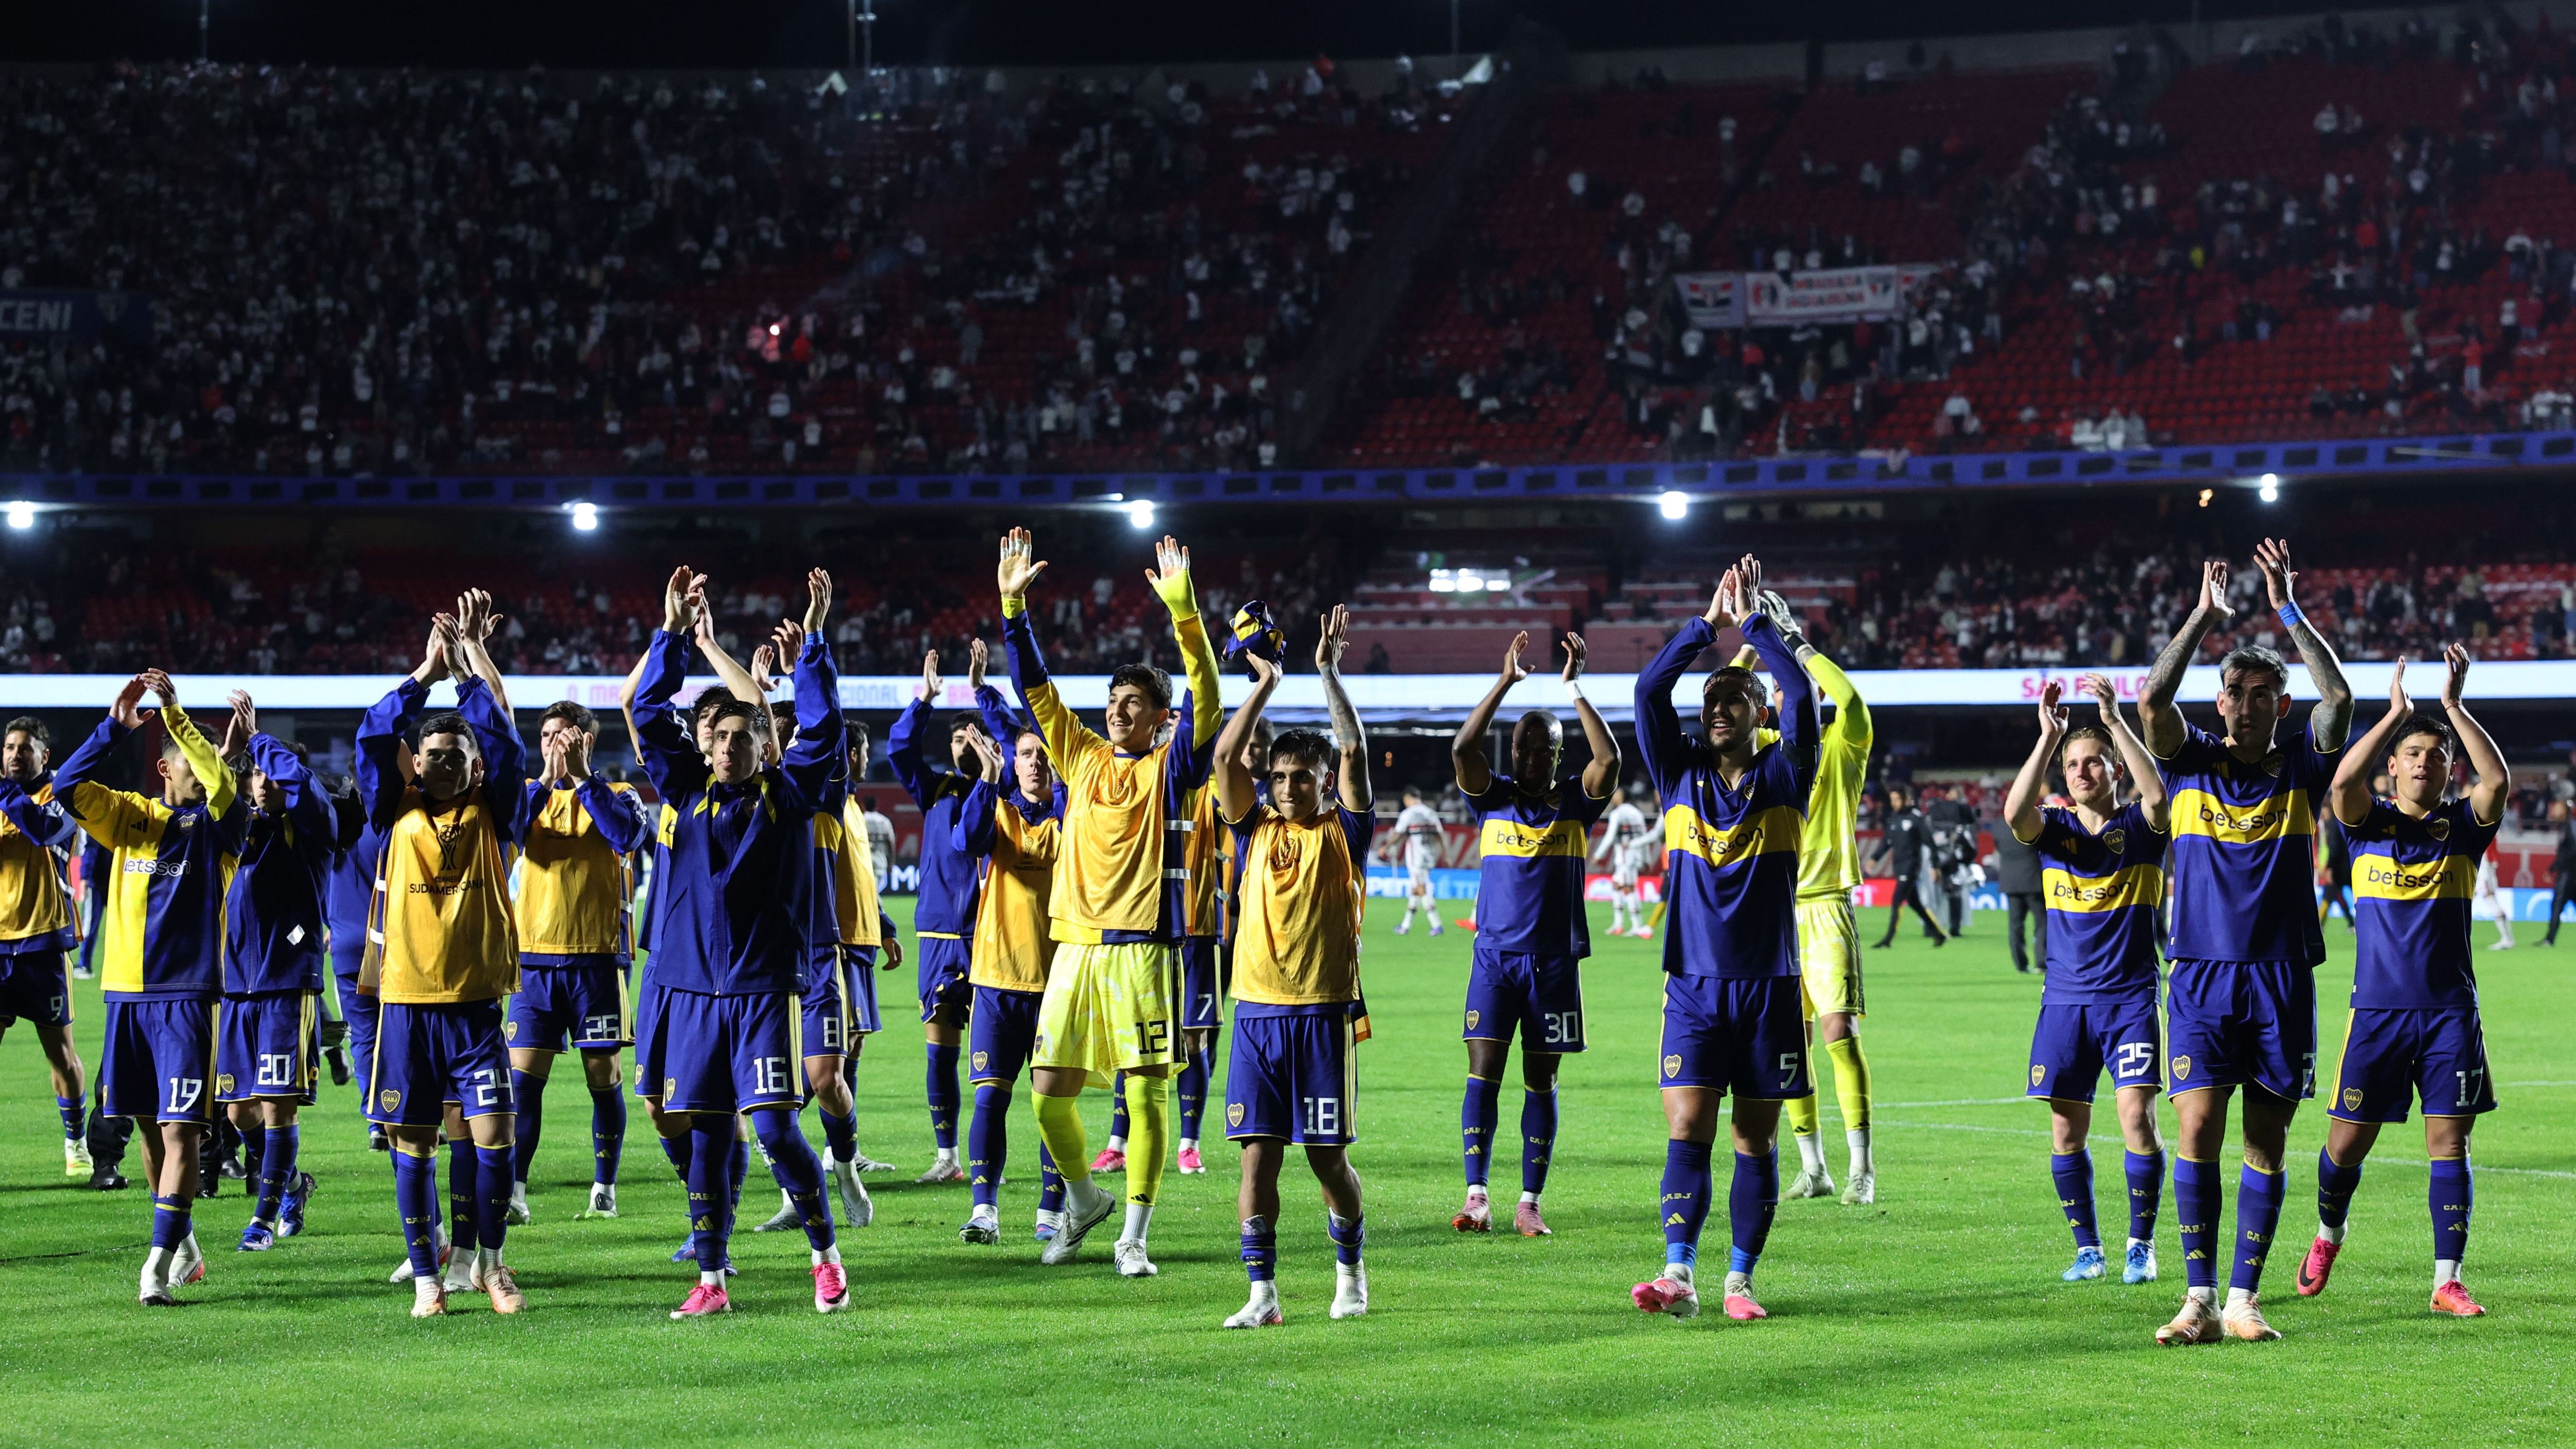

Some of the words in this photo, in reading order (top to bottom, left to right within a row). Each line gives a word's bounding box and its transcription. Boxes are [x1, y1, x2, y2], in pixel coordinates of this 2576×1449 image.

[2199, 804, 2289, 831] betsson
[1497, 830, 1569, 847] betsson
[1688, 822, 1764, 854] betsson
[2053, 881, 2131, 901] betsson
[2368, 866, 2454, 888] betsson
[51, 995, 64, 1021] 9
[1197, 993, 1213, 1021] 7
[585, 1014, 621, 1040] 26
[824, 1017, 840, 1048] 8
[1136, 1020, 1168, 1055] 12
[1544, 1011, 1579, 1043] 30
[257, 1053, 290, 1086] 20
[754, 1057, 789, 1094] 16
[1779, 1052, 1799, 1090] 5
[2118, 1042, 2154, 1079] 25
[166, 1077, 203, 1113] 19
[474, 1068, 514, 1107] 24
[2456, 1065, 2484, 1107] 17
[1303, 1097, 1339, 1135] 18
[1661, 1192, 1692, 1205] CABJ
